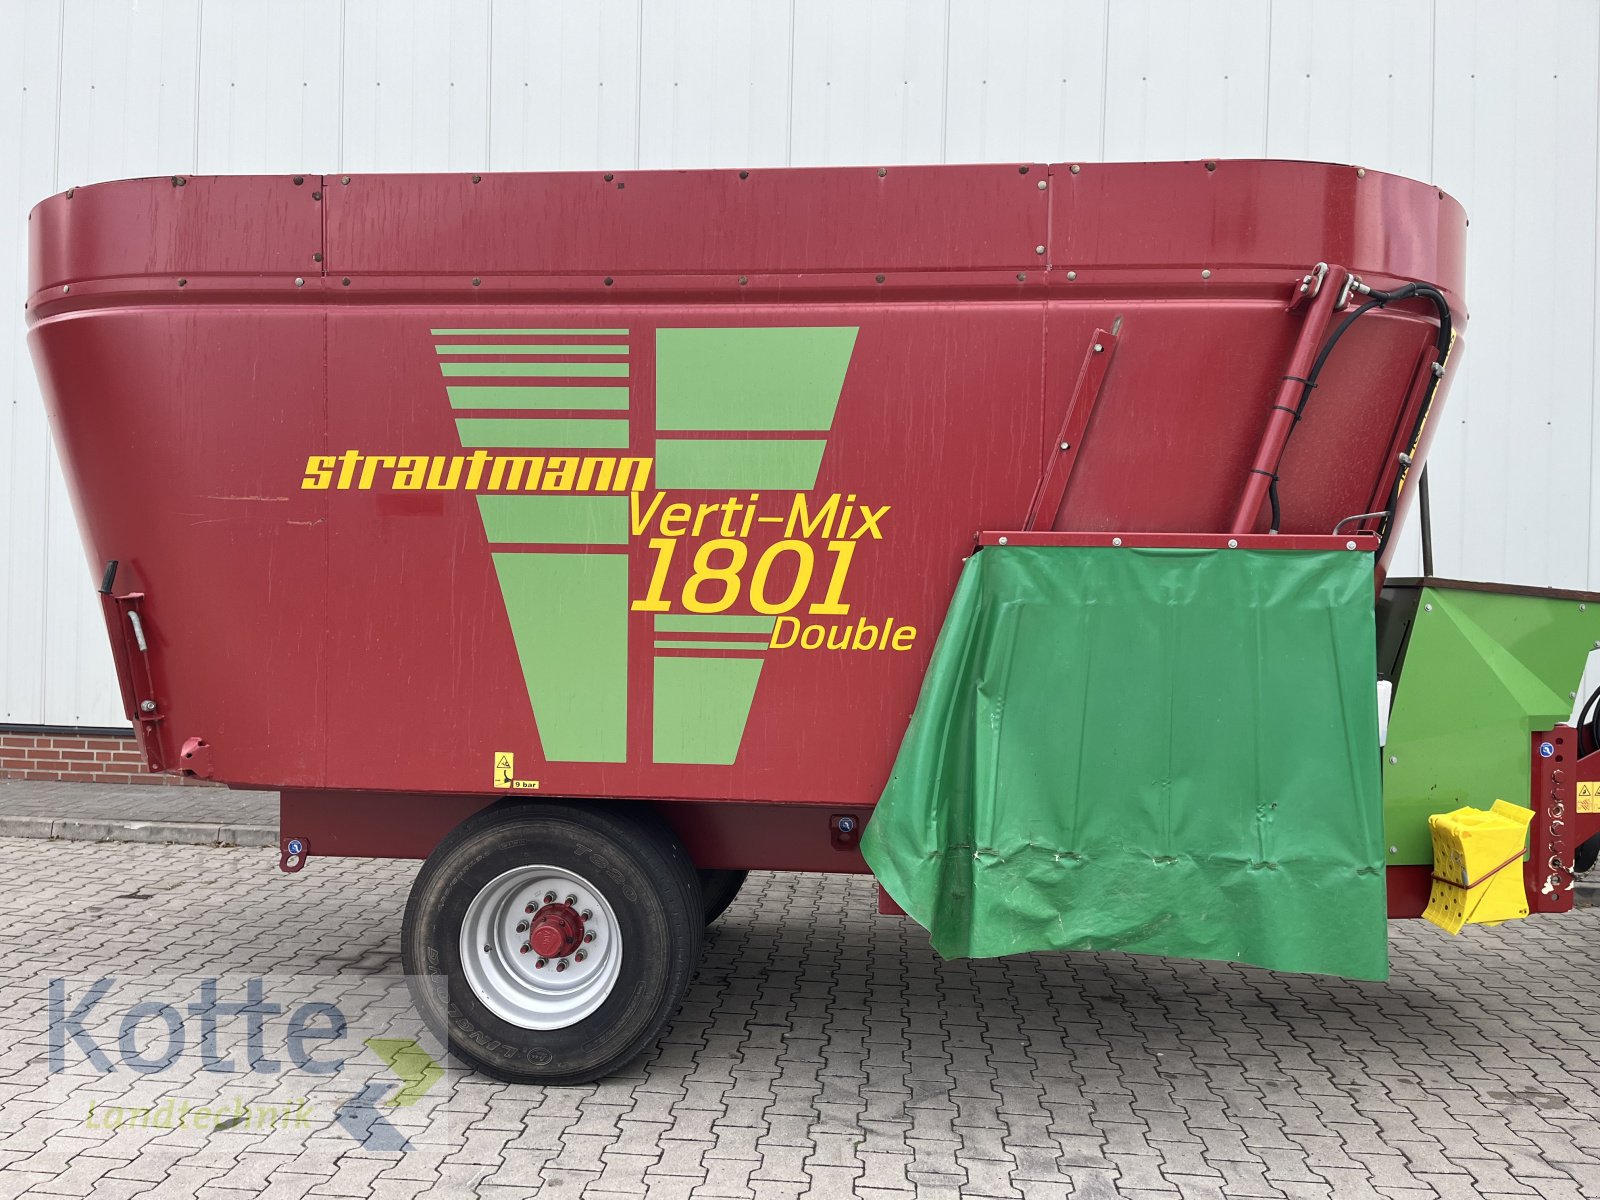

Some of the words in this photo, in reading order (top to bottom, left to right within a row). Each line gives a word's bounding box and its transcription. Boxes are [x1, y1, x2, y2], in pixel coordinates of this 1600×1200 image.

[301, 449, 653, 493] strautmann
[630, 491, 891, 539] Verti-Mix
[631, 538, 855, 616] 1801
[769, 616, 917, 651] Double
[427, 946, 519, 1059] LINGLONG
